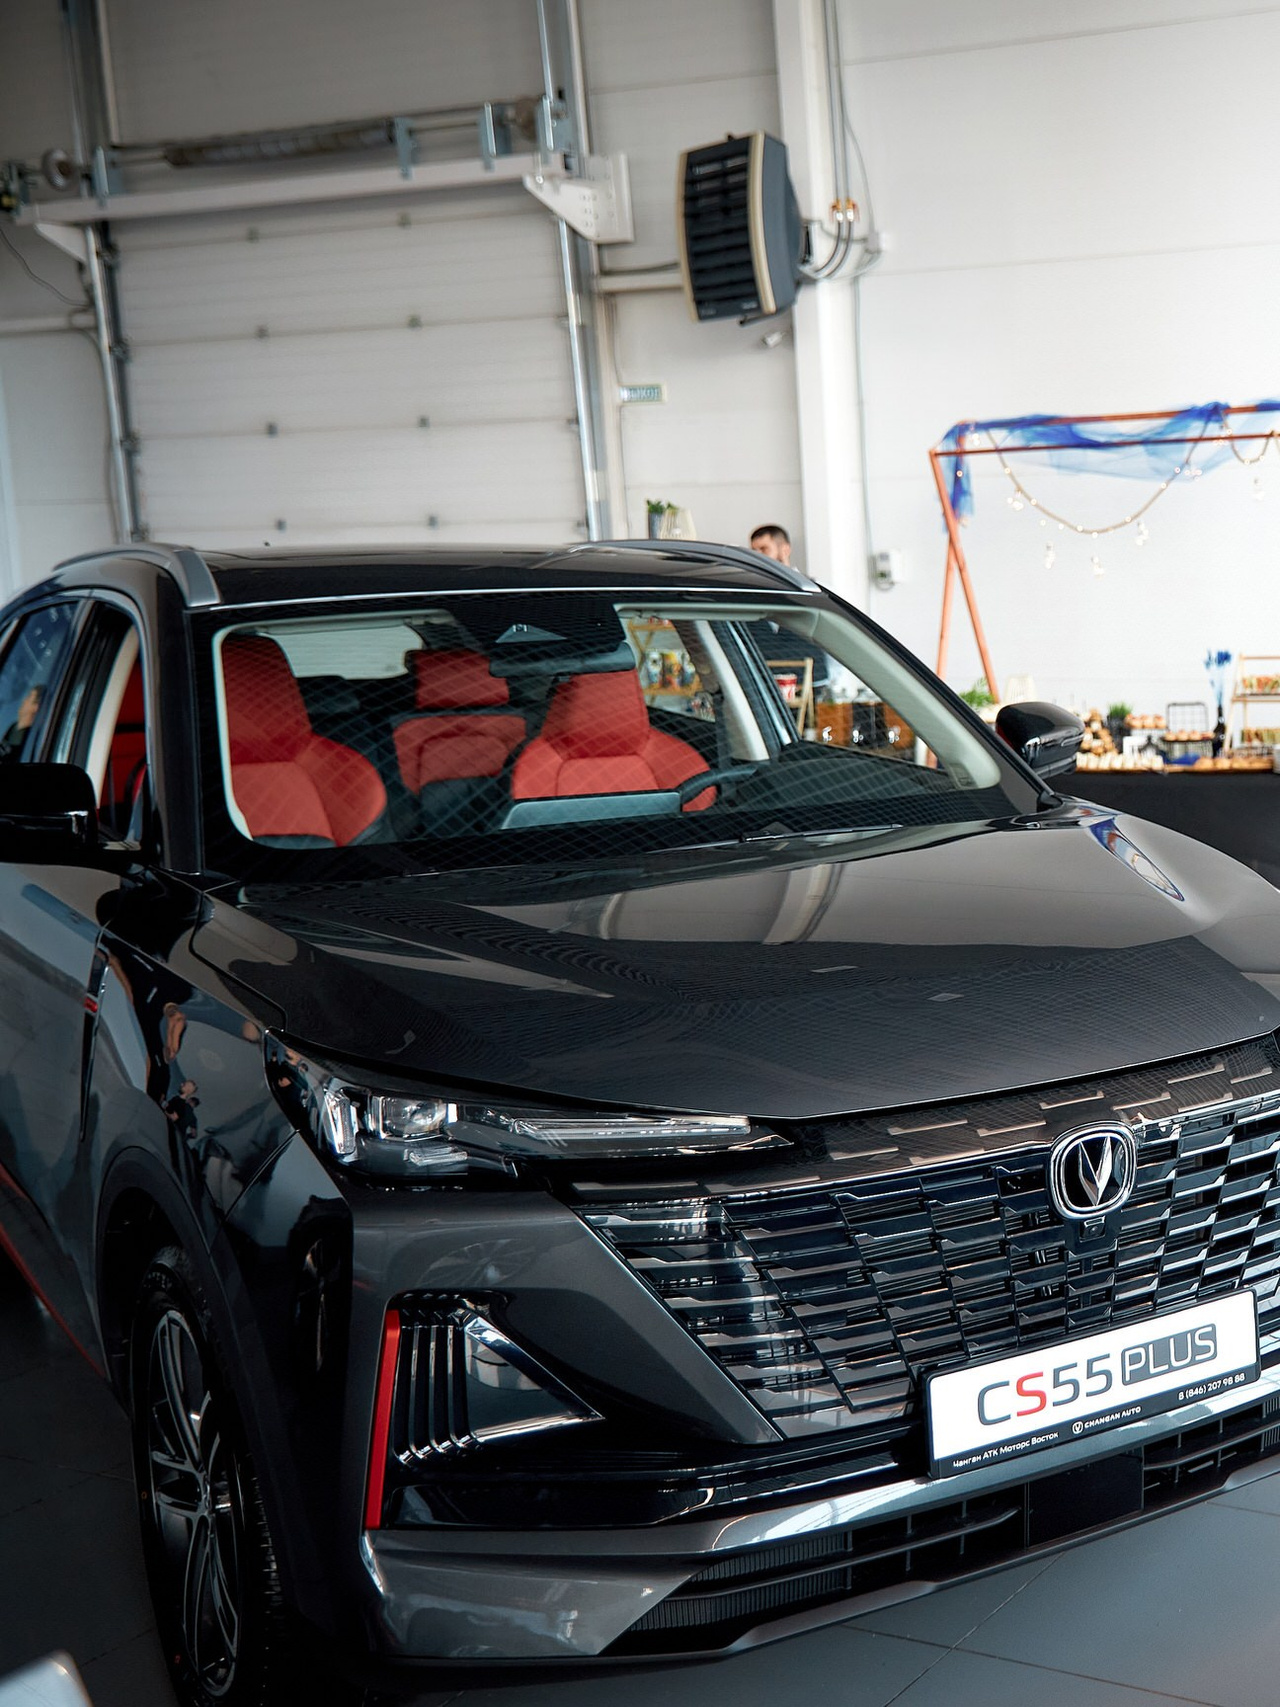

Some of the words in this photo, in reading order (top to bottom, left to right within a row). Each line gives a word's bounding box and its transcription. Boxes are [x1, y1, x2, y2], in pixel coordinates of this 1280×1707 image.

[978, 1353, 1113, 1426] CS55
[1125, 1326, 1216, 1382] PLUS
[1185, 1384, 1208, 1400] (846)
[1207, 1380, 1222, 1392] 207
[1084, 1412, 1121, 1429] CHANGAN
[1121, 1405, 1142, 1418] AUTO
[953, 1453, 982, 1468] Чанган
[982, 1448, 999, 1461] АТК
[999, 1440, 1031, 1455] Моторс
[1031, 1431, 1059, 1446] Восток
